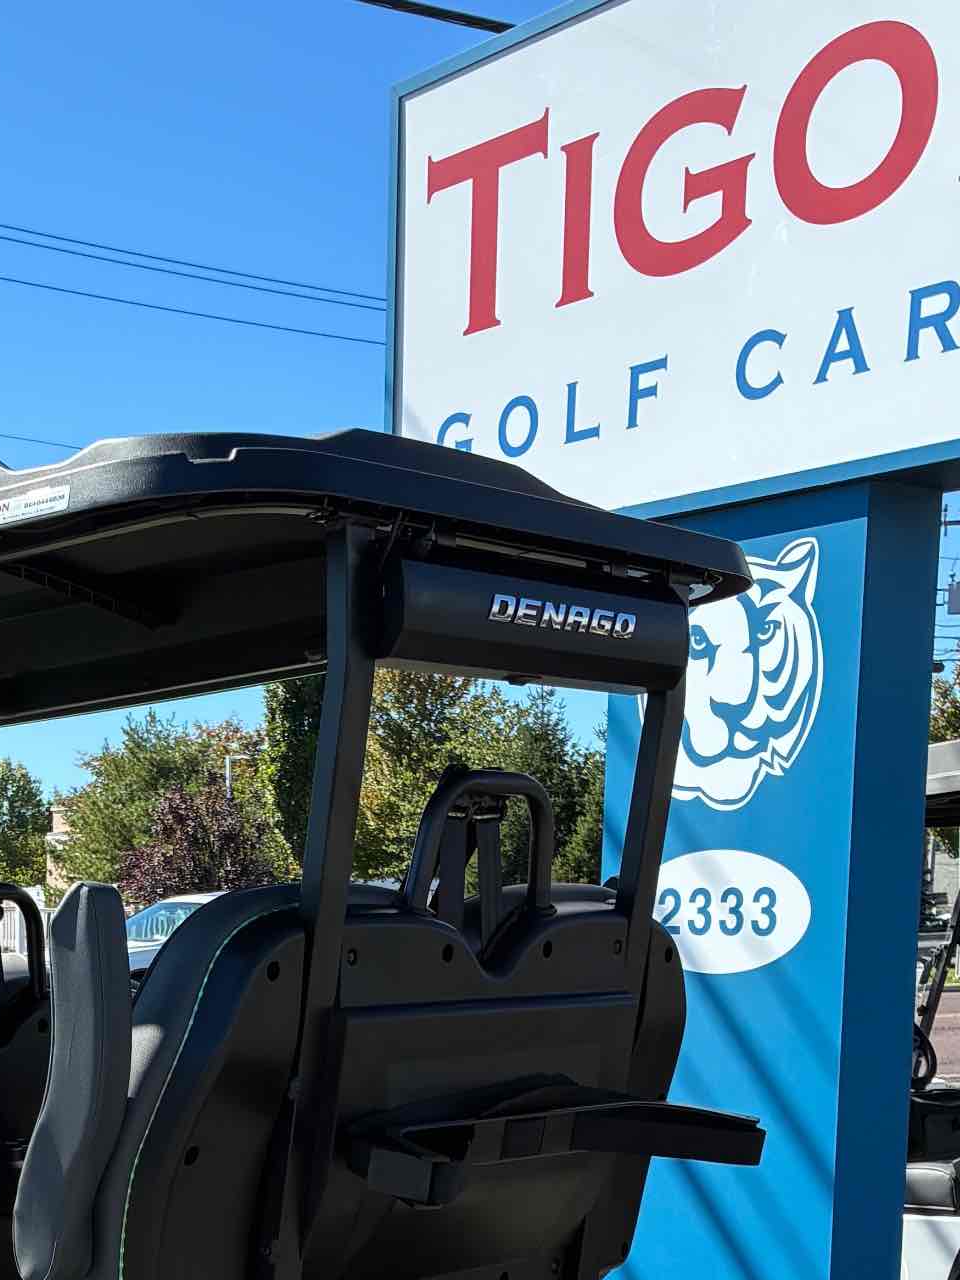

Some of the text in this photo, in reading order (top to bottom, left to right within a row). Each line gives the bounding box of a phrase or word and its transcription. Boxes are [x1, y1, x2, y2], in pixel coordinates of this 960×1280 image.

[426, 20, 960, 336] TIGO
[436, 279, 960, 458] GOLF CAR
[488, 593, 637, 639] DENAGO
[658, 887, 777, 936] 2333
